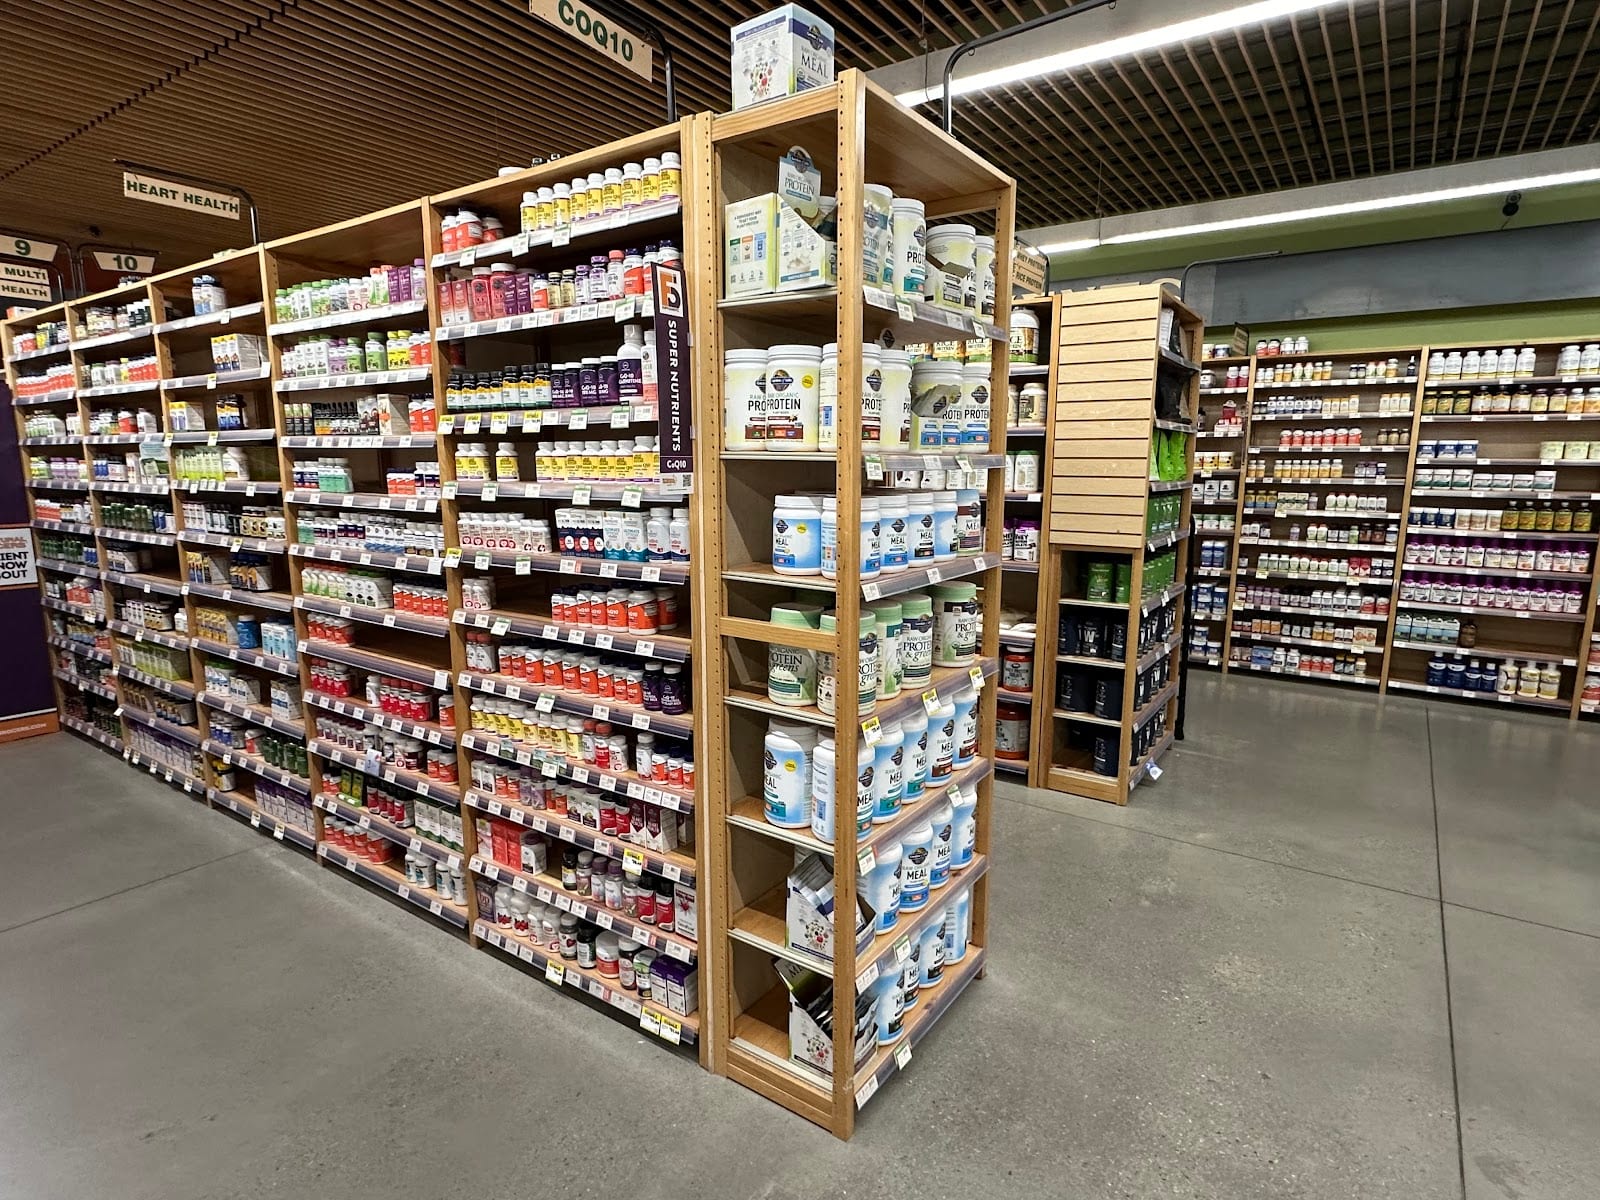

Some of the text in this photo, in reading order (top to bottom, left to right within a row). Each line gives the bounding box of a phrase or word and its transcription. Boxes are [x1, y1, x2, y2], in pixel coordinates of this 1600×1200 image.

[558, 0, 633, 62] COQ10
[801, 54, 829, 79] MEAL
[784, 176, 815, 196] PROTEIN
[126, 180, 239, 214] HEART HEALTH
[14, 239, 31, 256] 9
[113, 254, 138, 271] 10
[4, 266, 47, 280] MULTI
[1, 284, 48, 297] HEALTH
[668, 319, 681, 452] SUPER NUTRIENTS
[775, 391, 799, 399] ORGANIC
[766, 398, 801, 410] PROTEIN
[890, 537, 905, 546] MEAL
[0, 569, 28, 580] OUT
[906, 868, 928, 880] MEAL
